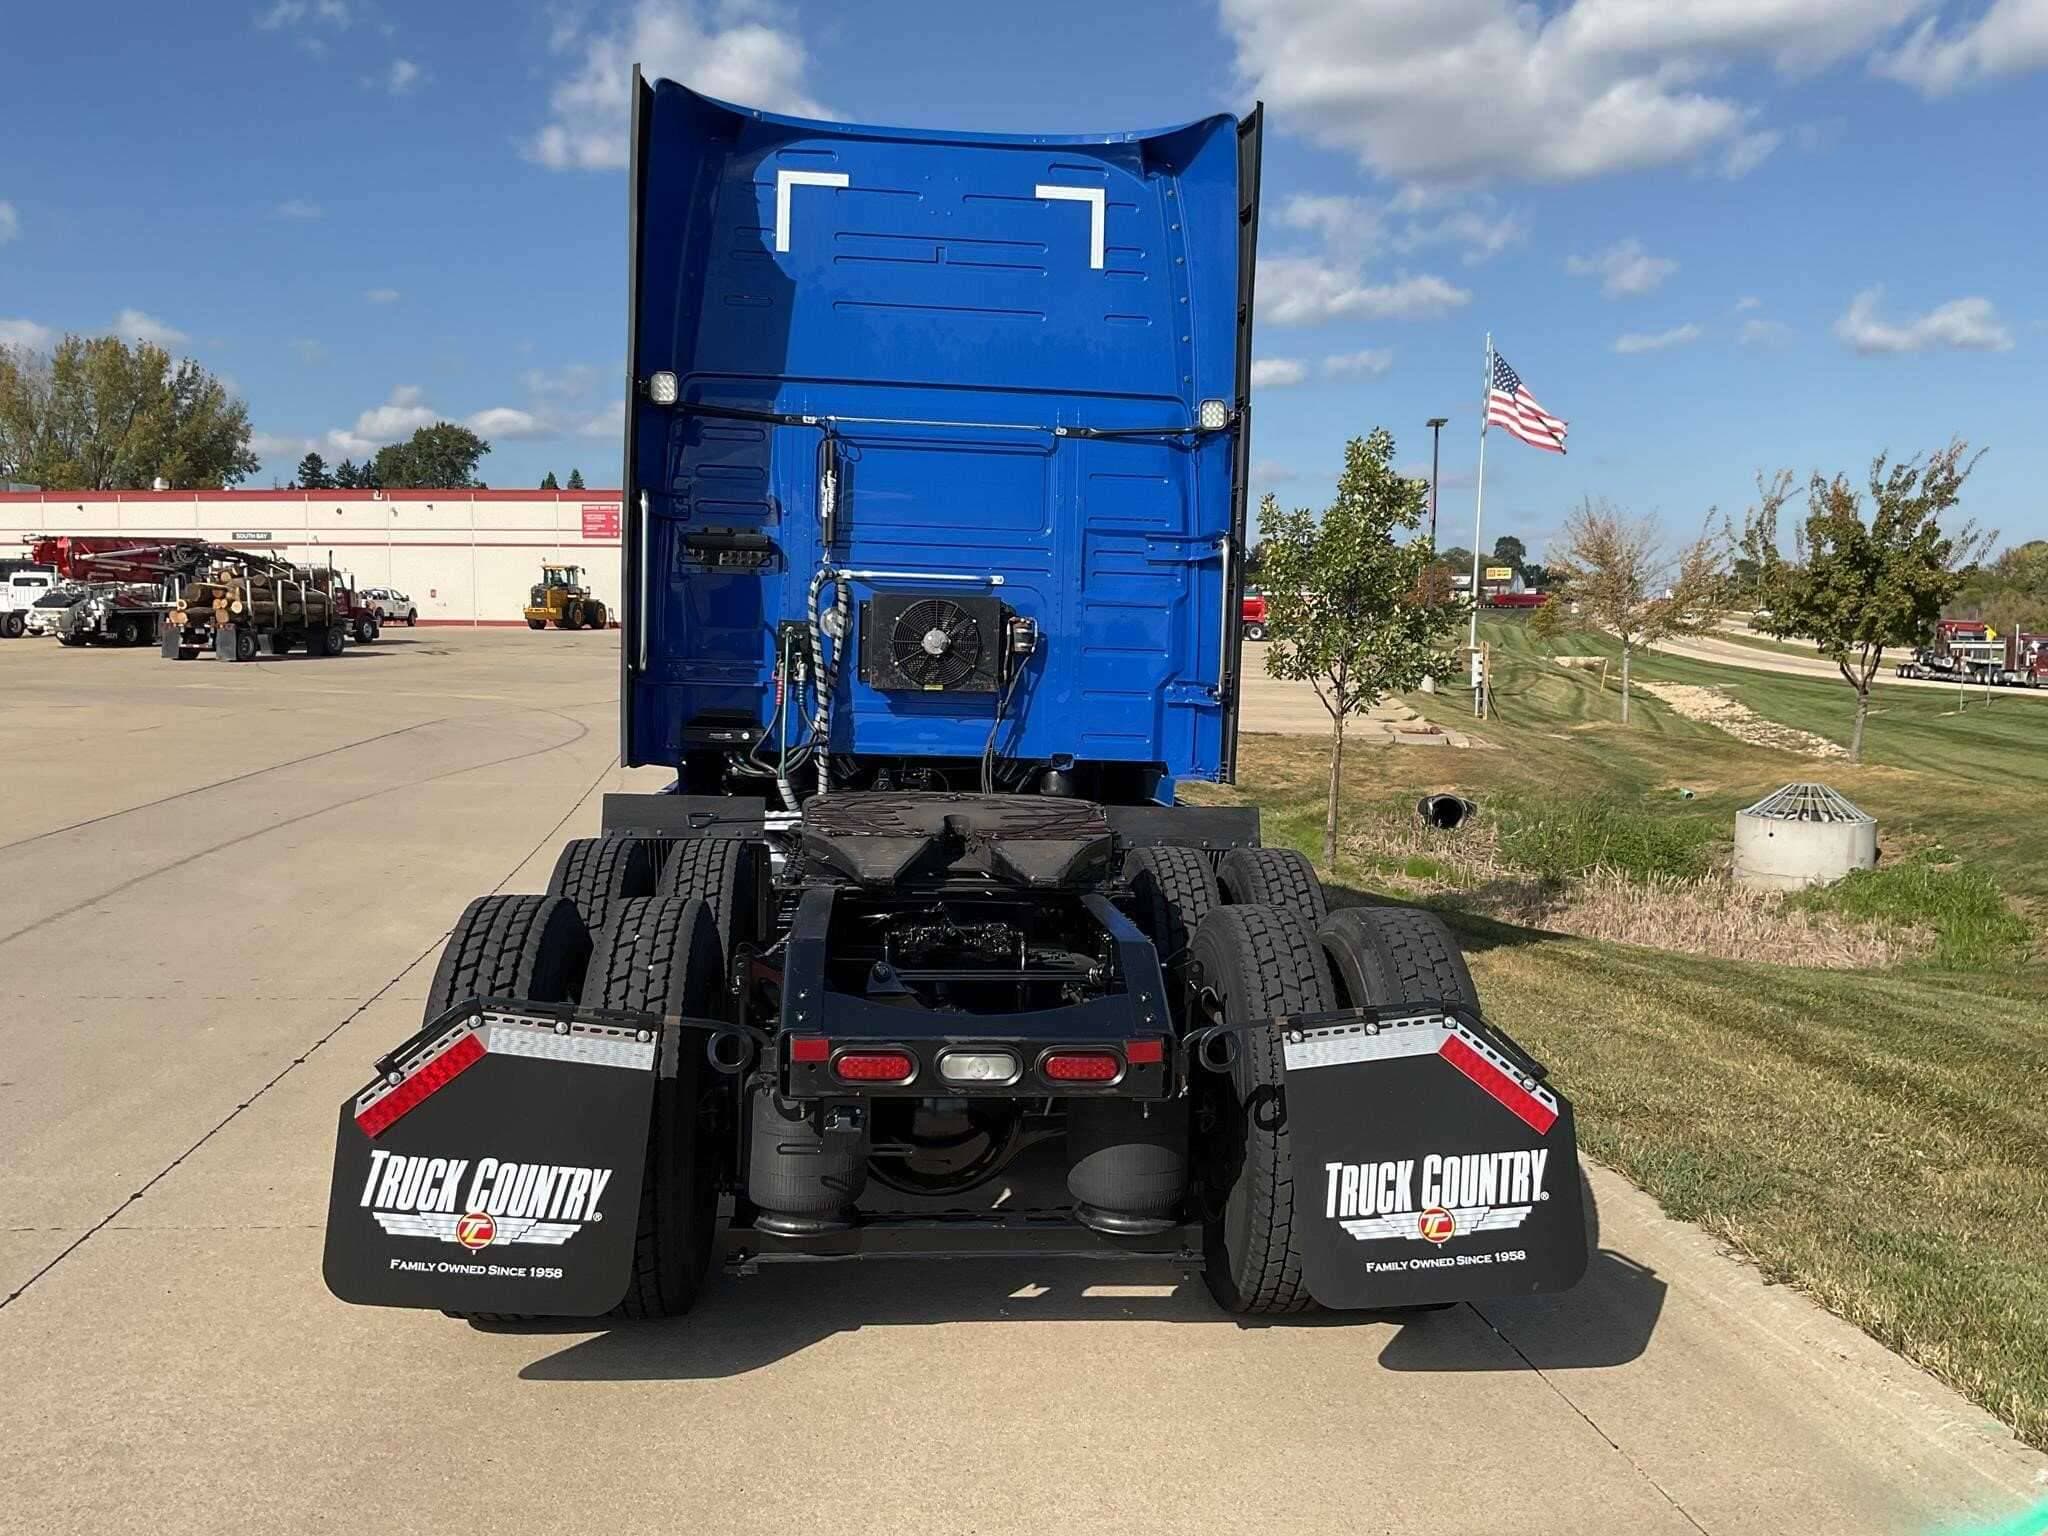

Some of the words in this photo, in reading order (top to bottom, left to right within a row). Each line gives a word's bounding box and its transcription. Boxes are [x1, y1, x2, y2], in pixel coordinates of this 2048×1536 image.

[360, 1149, 468, 1213] TRUCK
[465, 1157, 612, 1221] COUNTRY
[1324, 1161, 1415, 1218] TRUCK
[1421, 1148, 1549, 1208] COUNTRY
[390, 1258, 436, 1273] FAMILY
[437, 1262, 487, 1276] OWNED
[488, 1266, 526, 1278] SINCE
[529, 1266, 564, 1279] 1958
[1366, 1259, 1408, 1273] FAMILY
[1409, 1256, 1455, 1269] OWNED
[1456, 1252, 1493, 1266] SINCE
[1495, 1250, 1527, 1263] 1958
